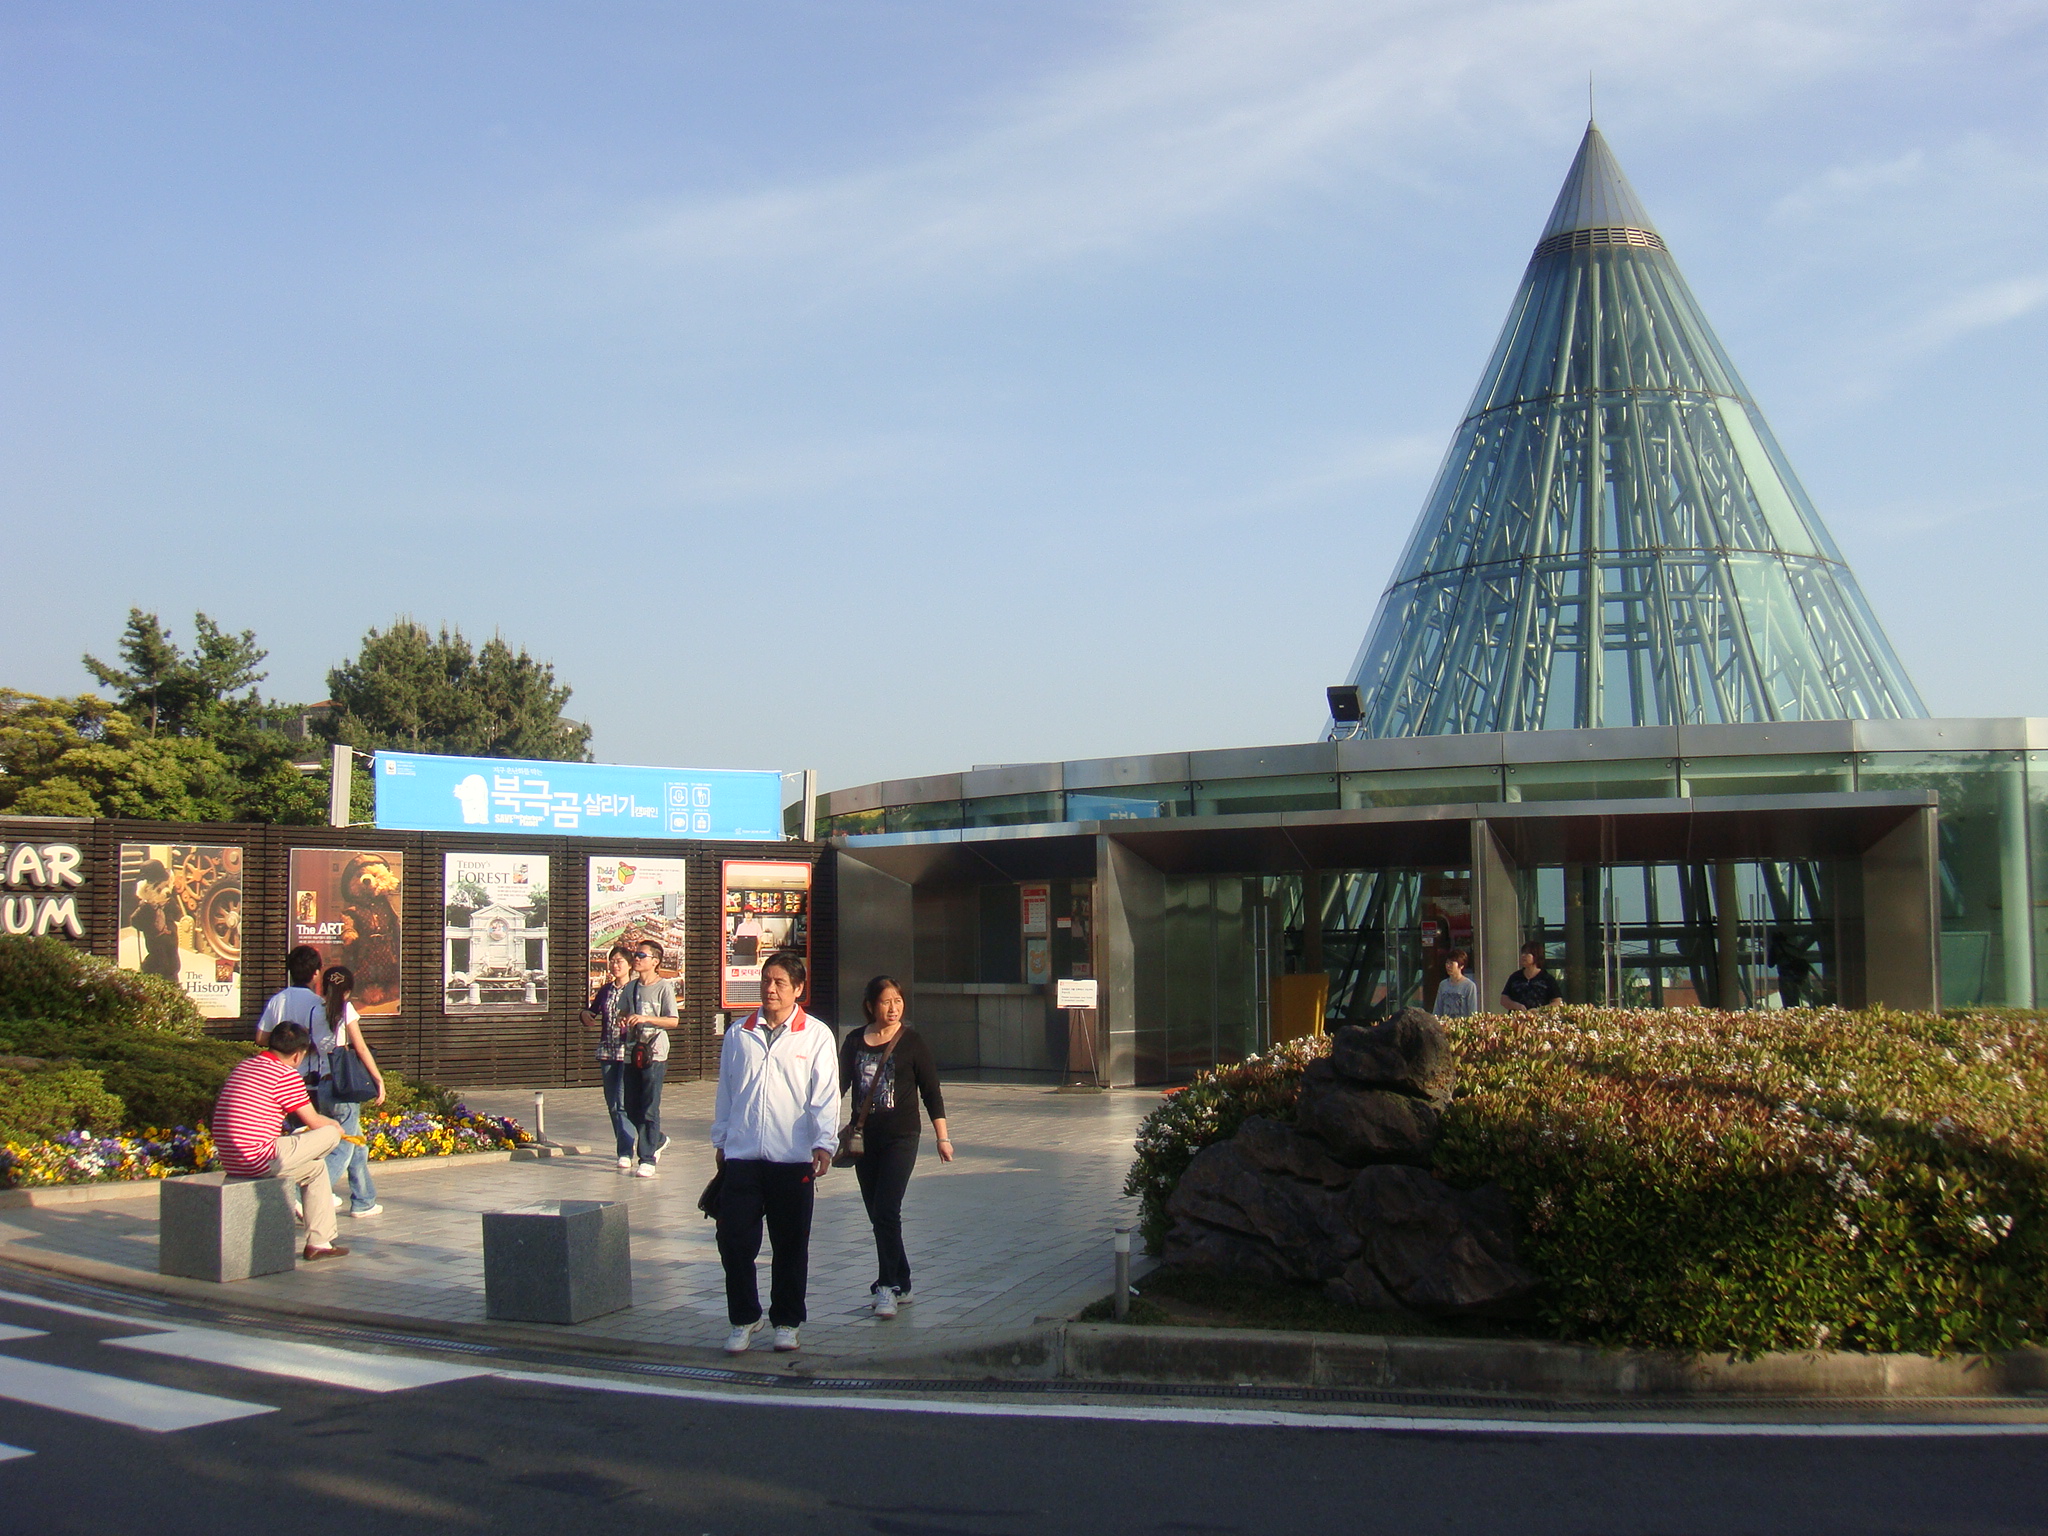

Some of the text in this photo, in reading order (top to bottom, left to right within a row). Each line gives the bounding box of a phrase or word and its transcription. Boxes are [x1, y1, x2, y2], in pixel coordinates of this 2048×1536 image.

[491, 774, 582, 828] 북극곰
[583, 793, 634, 817] 살리기
[0, 844, 84, 886] AR
[457, 870, 510, 884] FOREST
[296, 923, 344, 934] The ART
[186, 971, 203, 979] The
[186, 981, 232, 996] History
